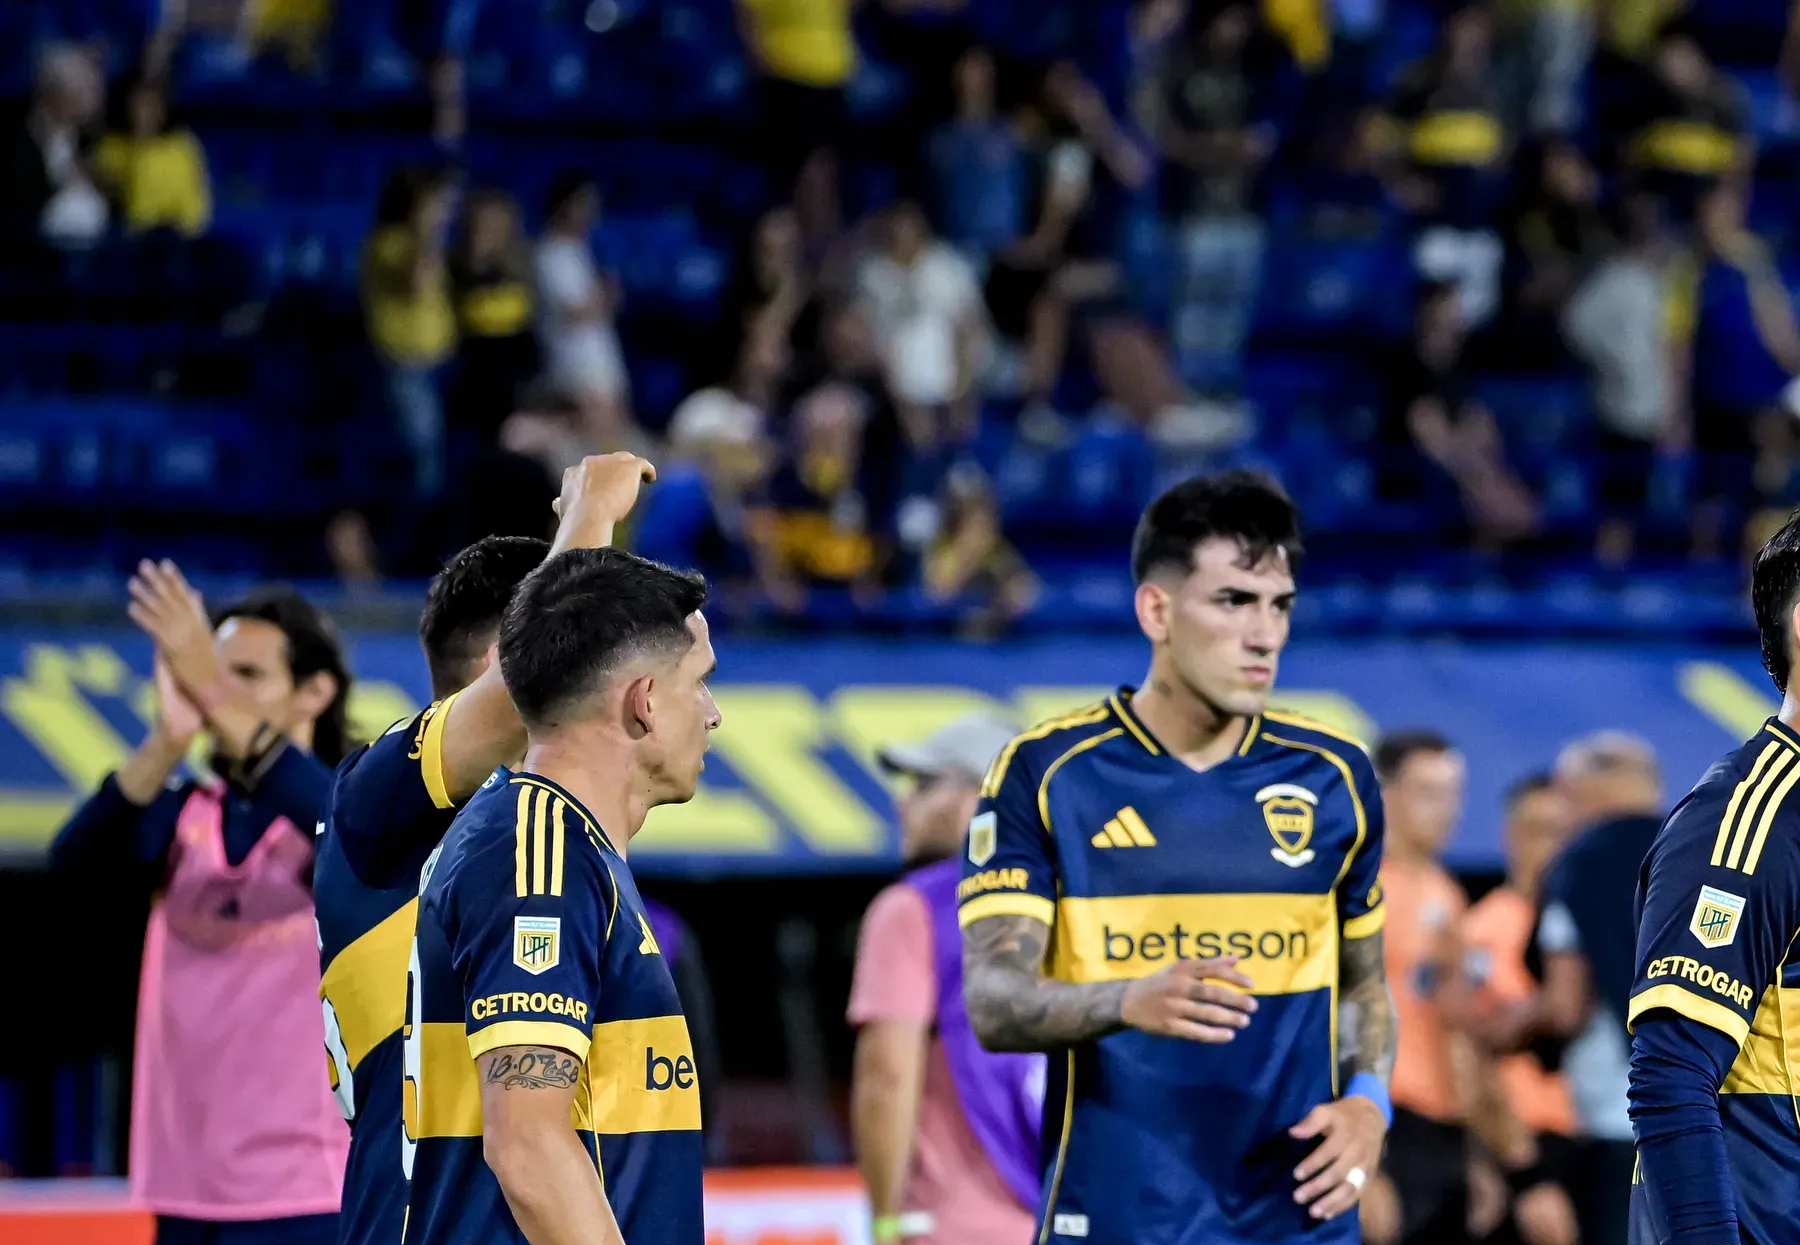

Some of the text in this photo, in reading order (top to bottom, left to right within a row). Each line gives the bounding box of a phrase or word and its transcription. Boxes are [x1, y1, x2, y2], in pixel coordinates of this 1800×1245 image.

[1104, 922, 1309, 961] betsson
[1647, 955, 1754, 1011] CETROGAR
[471, 991, 589, 1026] CETROGAR
